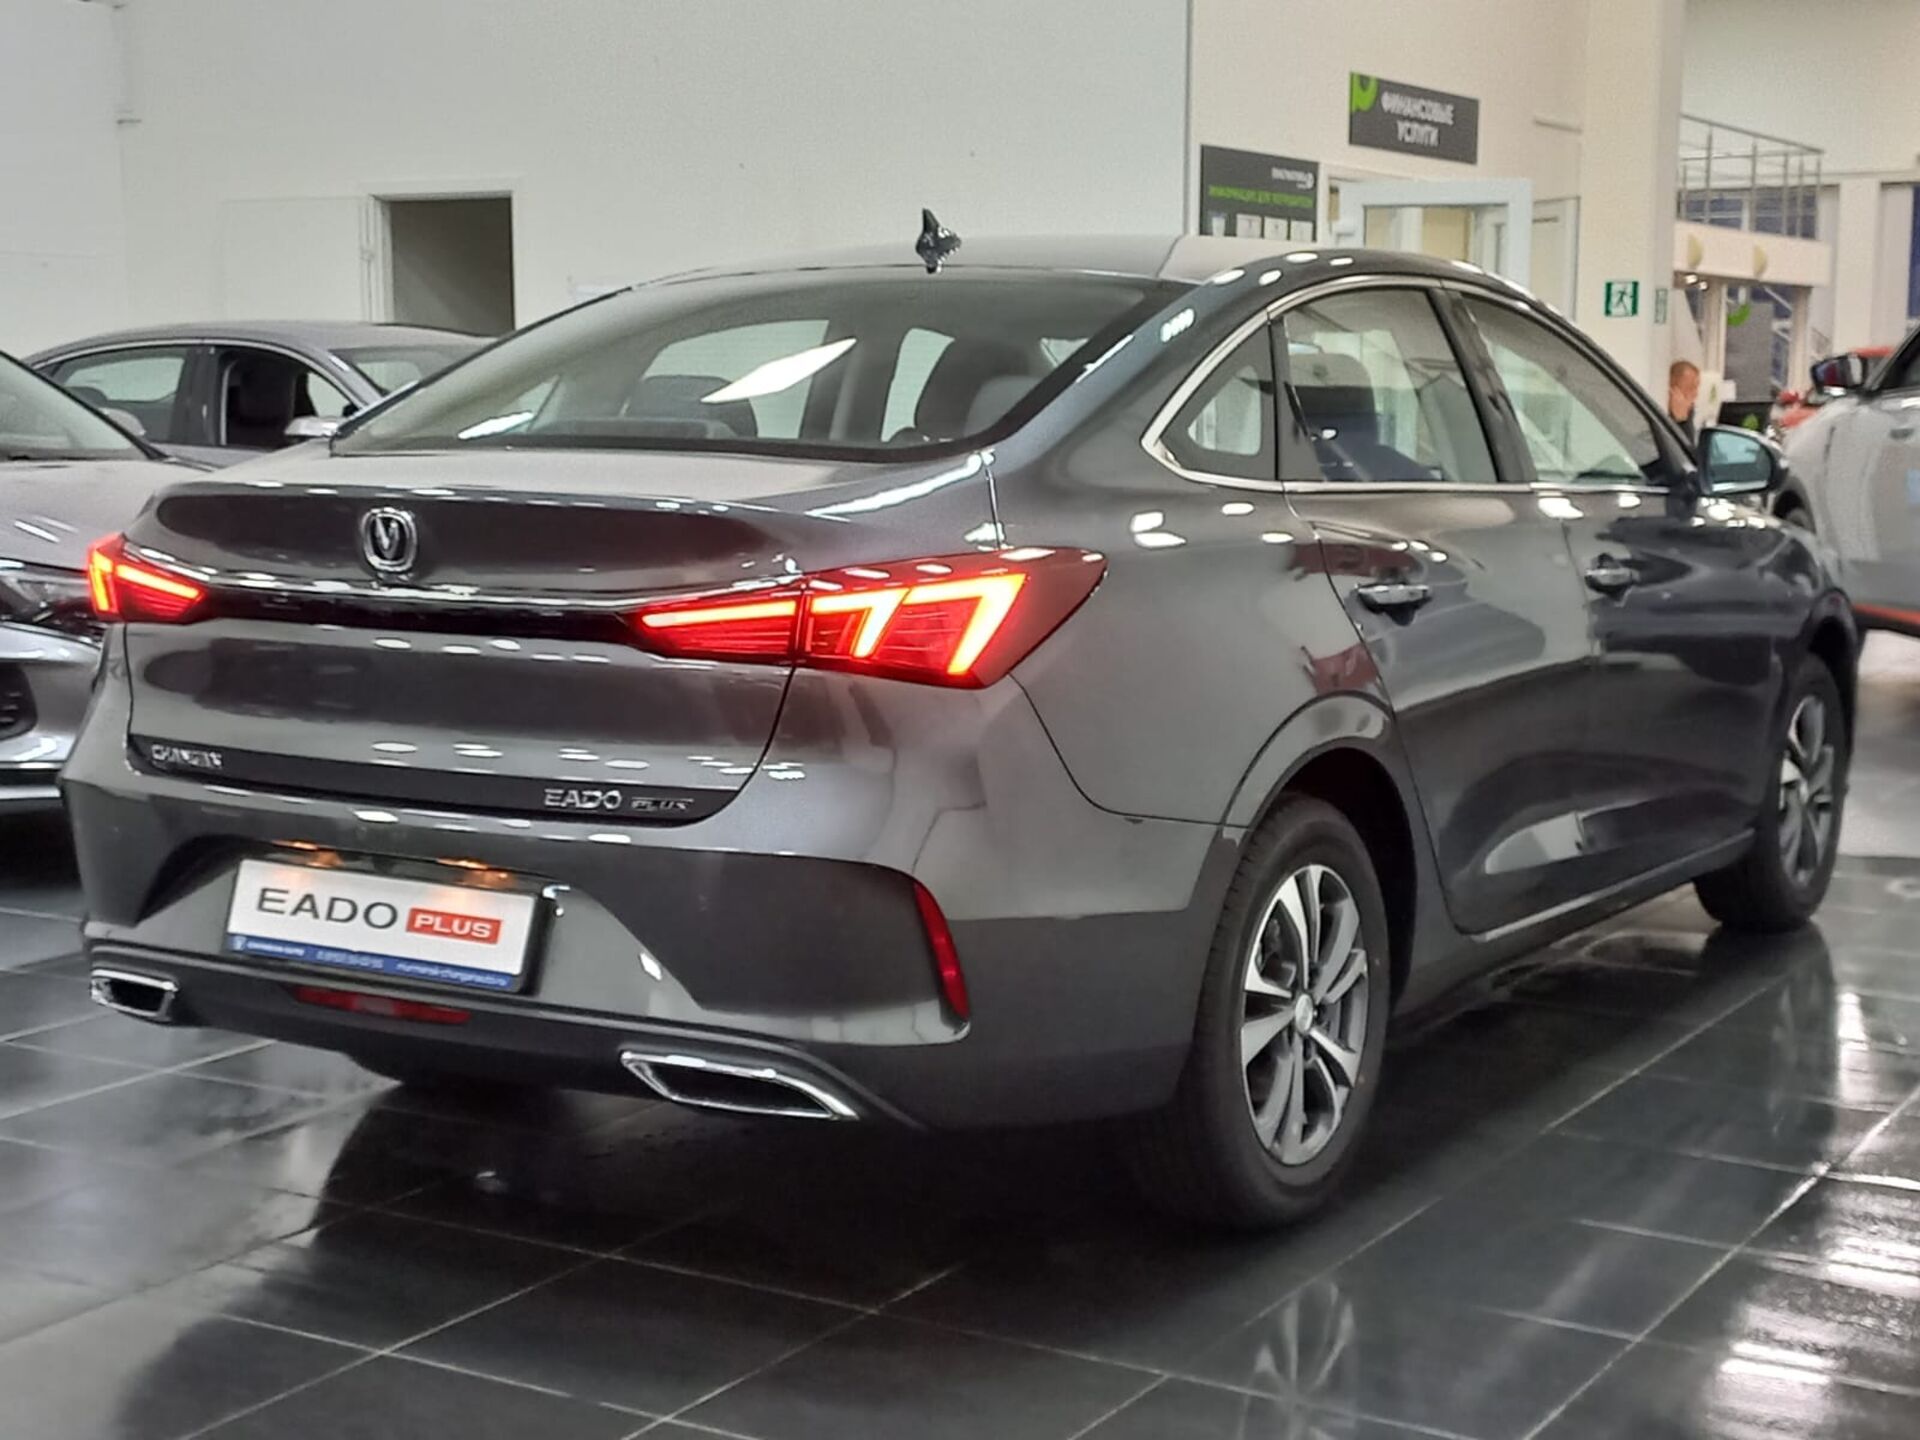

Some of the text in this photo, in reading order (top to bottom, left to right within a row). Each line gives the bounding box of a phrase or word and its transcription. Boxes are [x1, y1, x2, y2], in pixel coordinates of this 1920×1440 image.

[1397, 120, 1439, 147] УСЛУГИ
[544, 788, 694, 812] EADO PLUS
[256, 887, 492, 939] EADO PLUS
